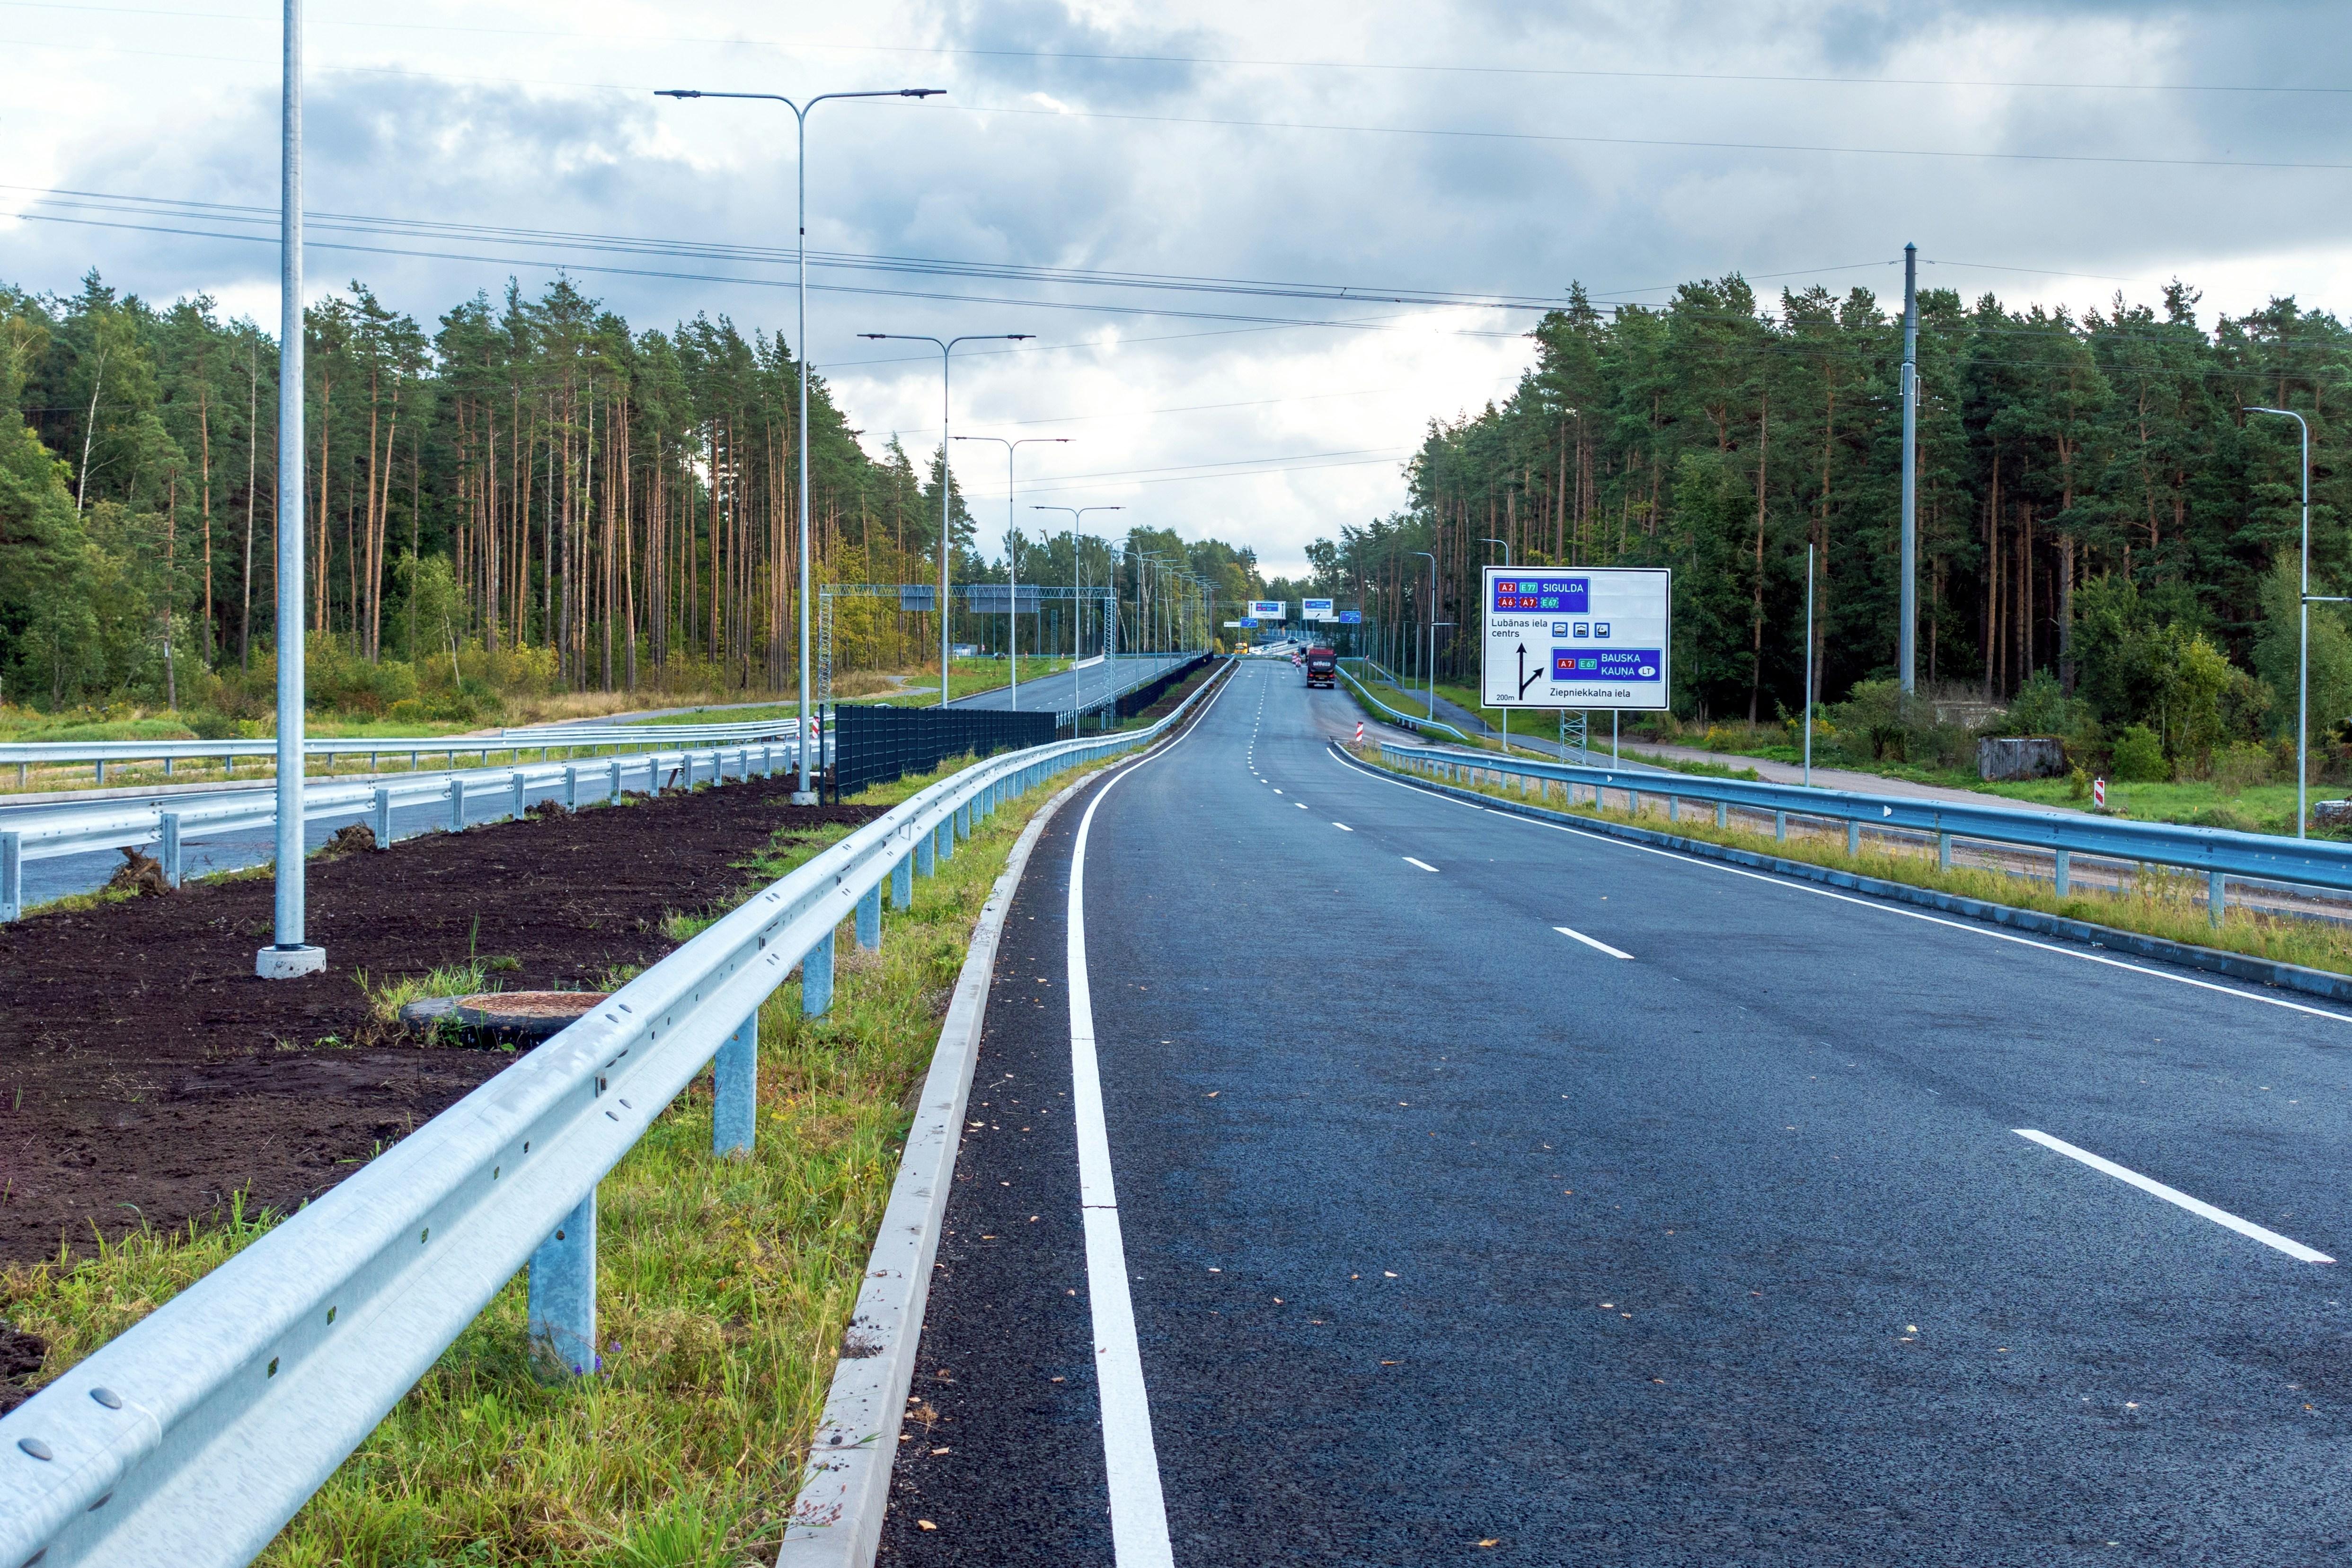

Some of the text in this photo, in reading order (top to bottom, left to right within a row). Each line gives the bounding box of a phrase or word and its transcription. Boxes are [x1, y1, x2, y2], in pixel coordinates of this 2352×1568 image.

[1543, 583, 1583, 592] SIGULDA
[1492, 618, 1547, 627] Lubānas iela
[1492, 629, 1520, 637] centrs
[1601, 653, 1641, 662] BAUSKA
[1601, 667, 1635, 678] KAUŅA
[1550, 687, 1630, 698] Ziepniekkalna iela
